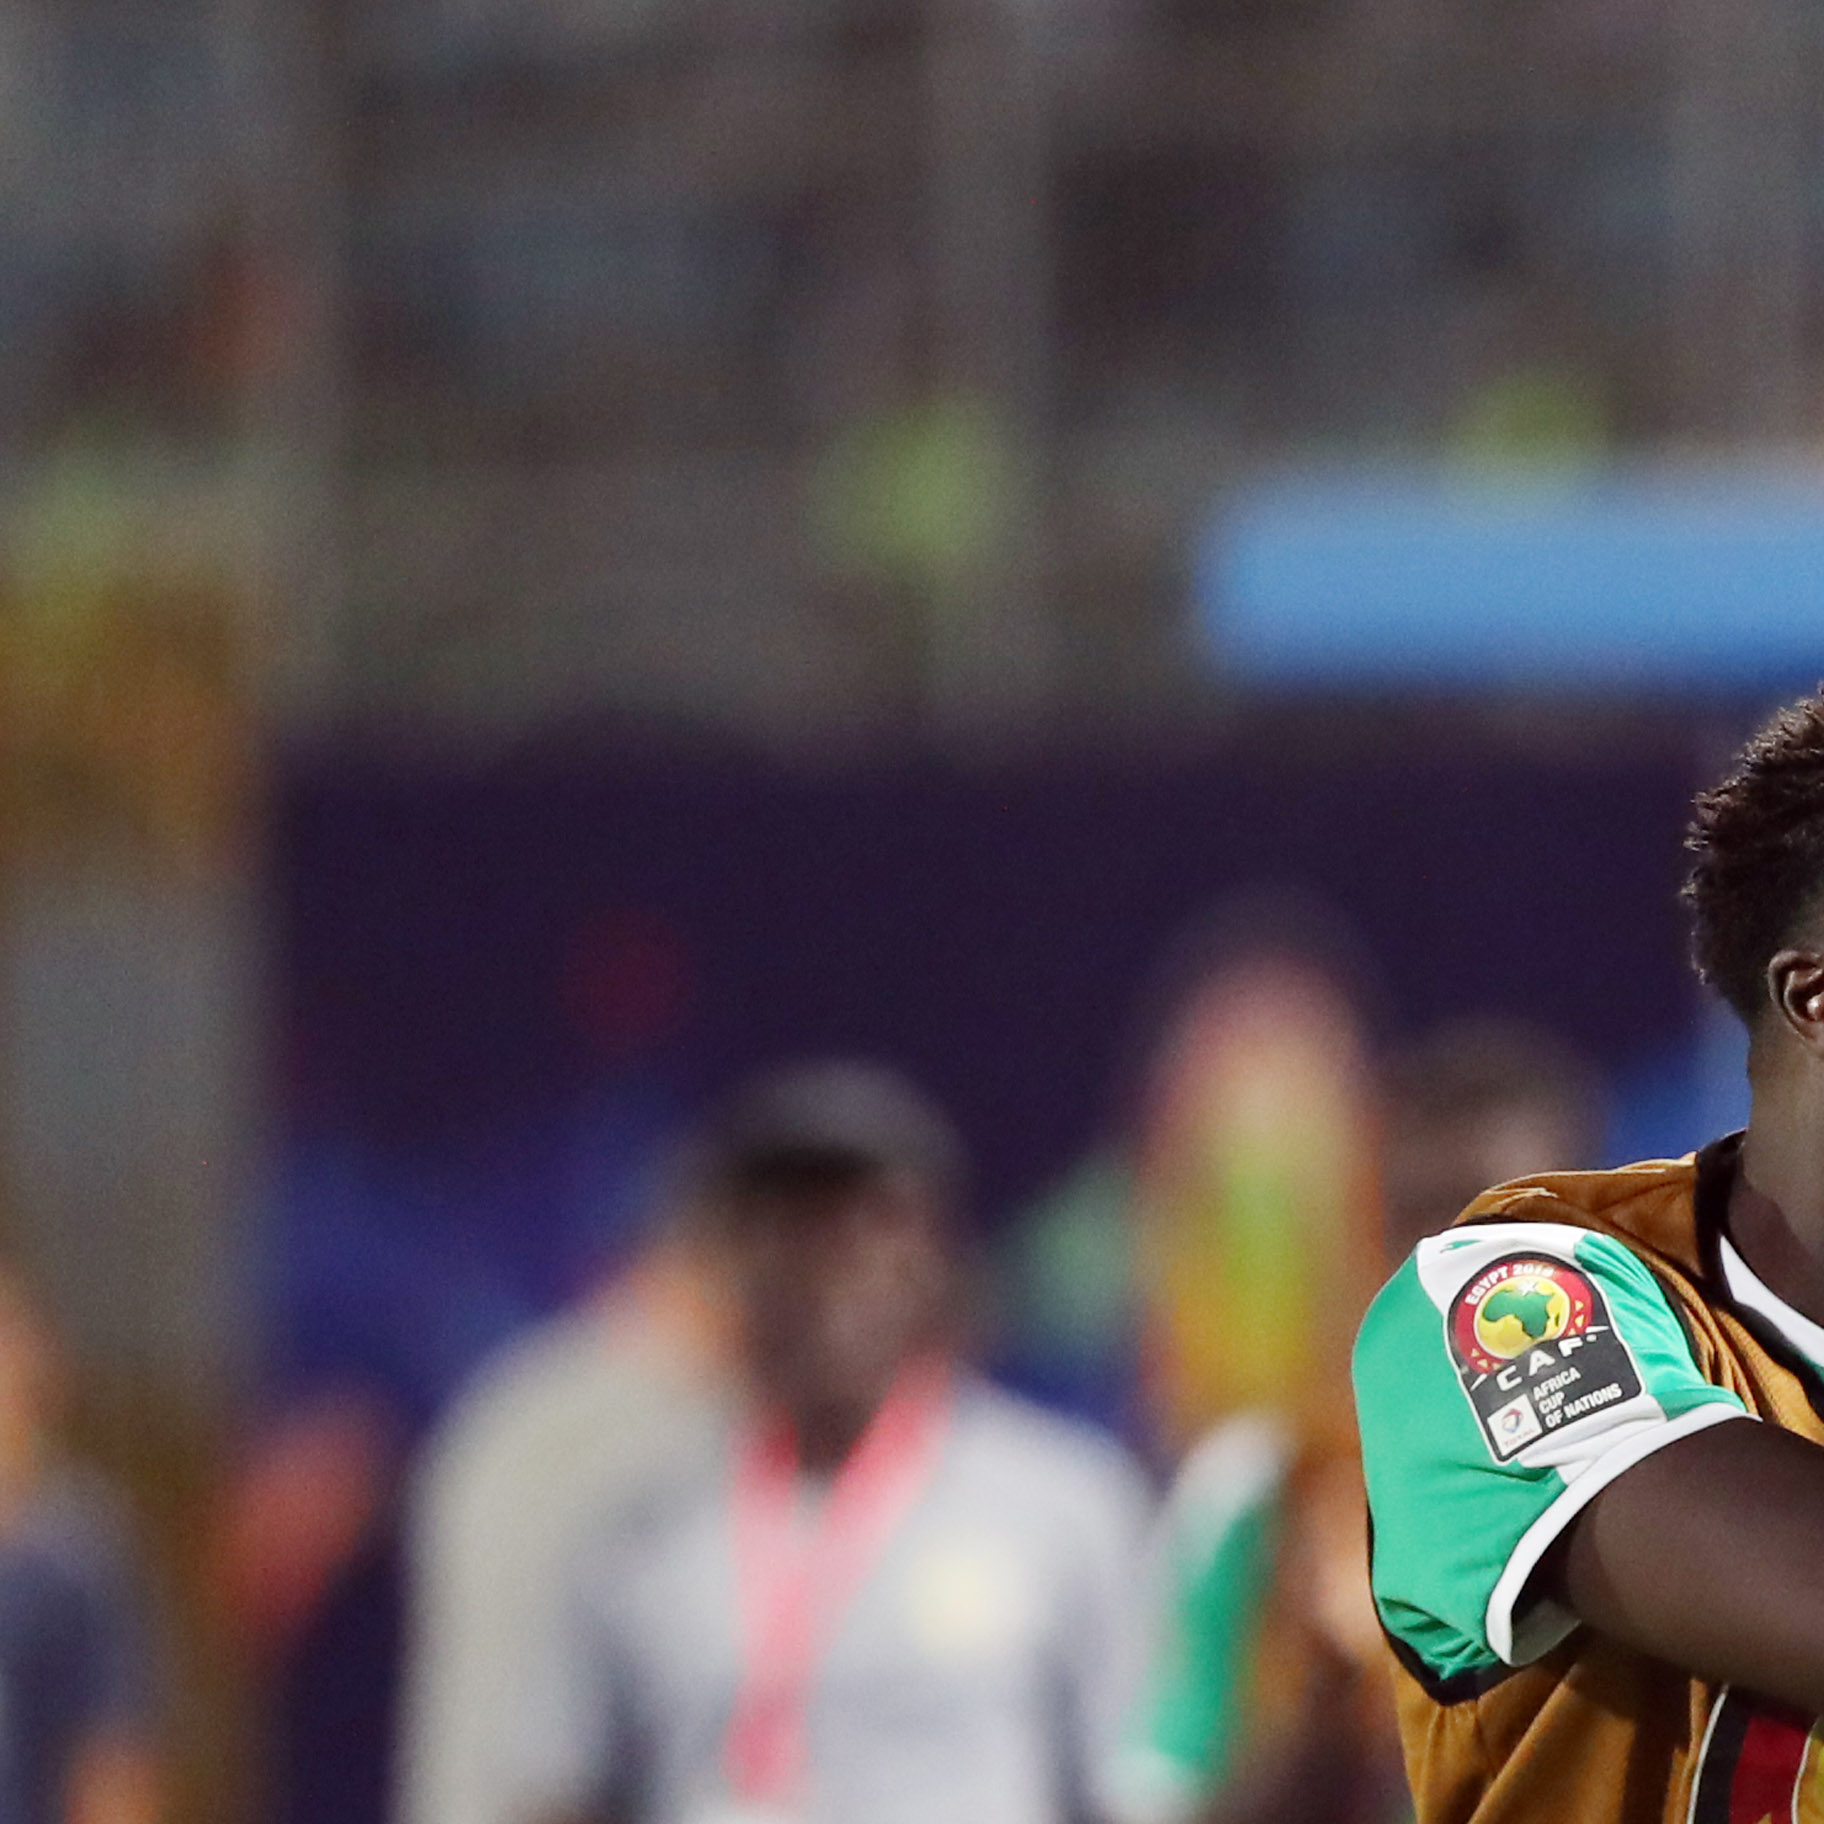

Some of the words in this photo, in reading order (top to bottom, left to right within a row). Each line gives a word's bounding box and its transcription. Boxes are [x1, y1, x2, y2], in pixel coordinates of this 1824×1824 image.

[1464, 1266, 1508, 1305] EGYPT
[1496, 1337, 1583, 1391] CAF
[1533, 1367, 1581, 1401] AFRICA
[1539, 1391, 1565, 1414] CUP
[1545, 1409, 1563, 1428] OF
[1563, 1382, 1622, 1418] NATIONS
